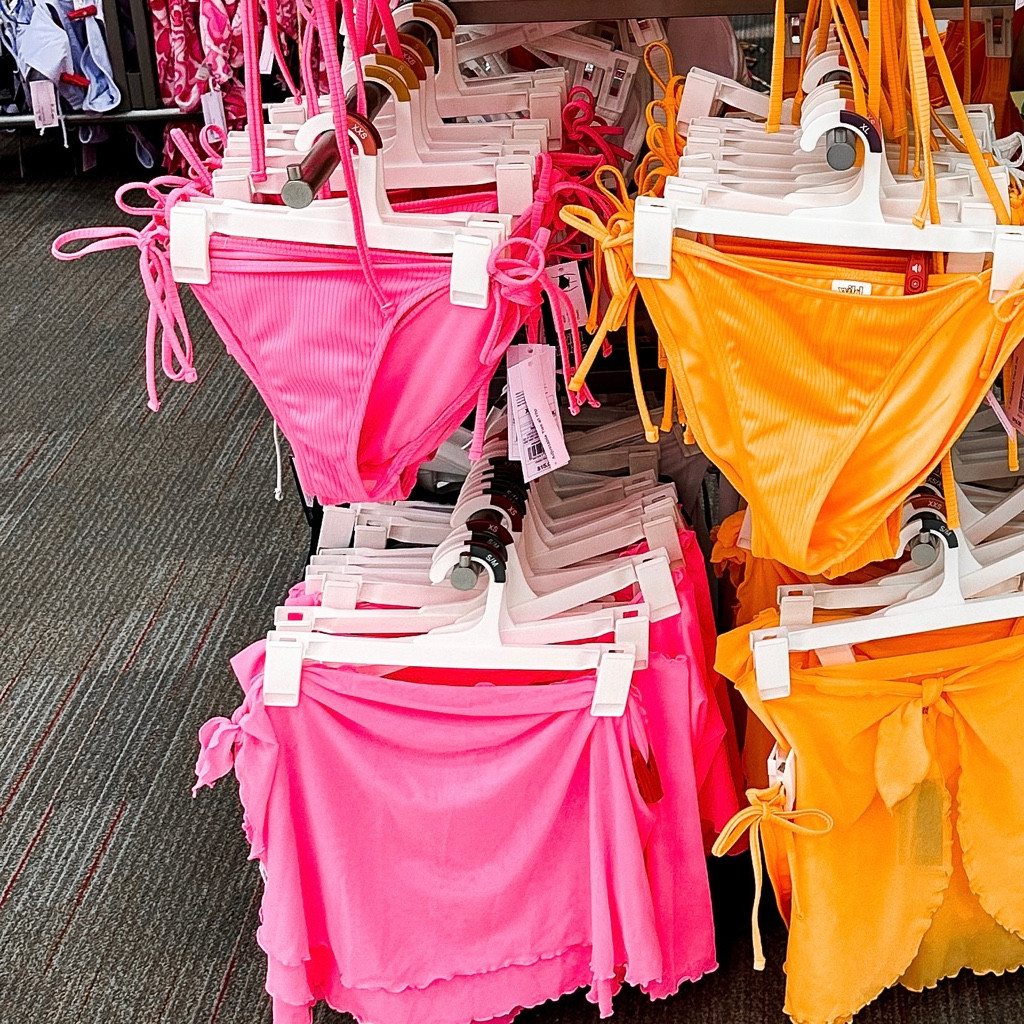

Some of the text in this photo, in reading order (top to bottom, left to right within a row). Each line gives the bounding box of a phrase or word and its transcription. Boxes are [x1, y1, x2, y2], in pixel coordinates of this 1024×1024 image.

[352, 123, 368, 140] XXS
[860, 123, 871, 135] XL
[928, 500, 942, 510] XXS
[506, 506, 518, 516] XS
[488, 524, 498, 533] XS
[939, 525, 952, 536] S/M
[485, 554, 499, 568] S/M
